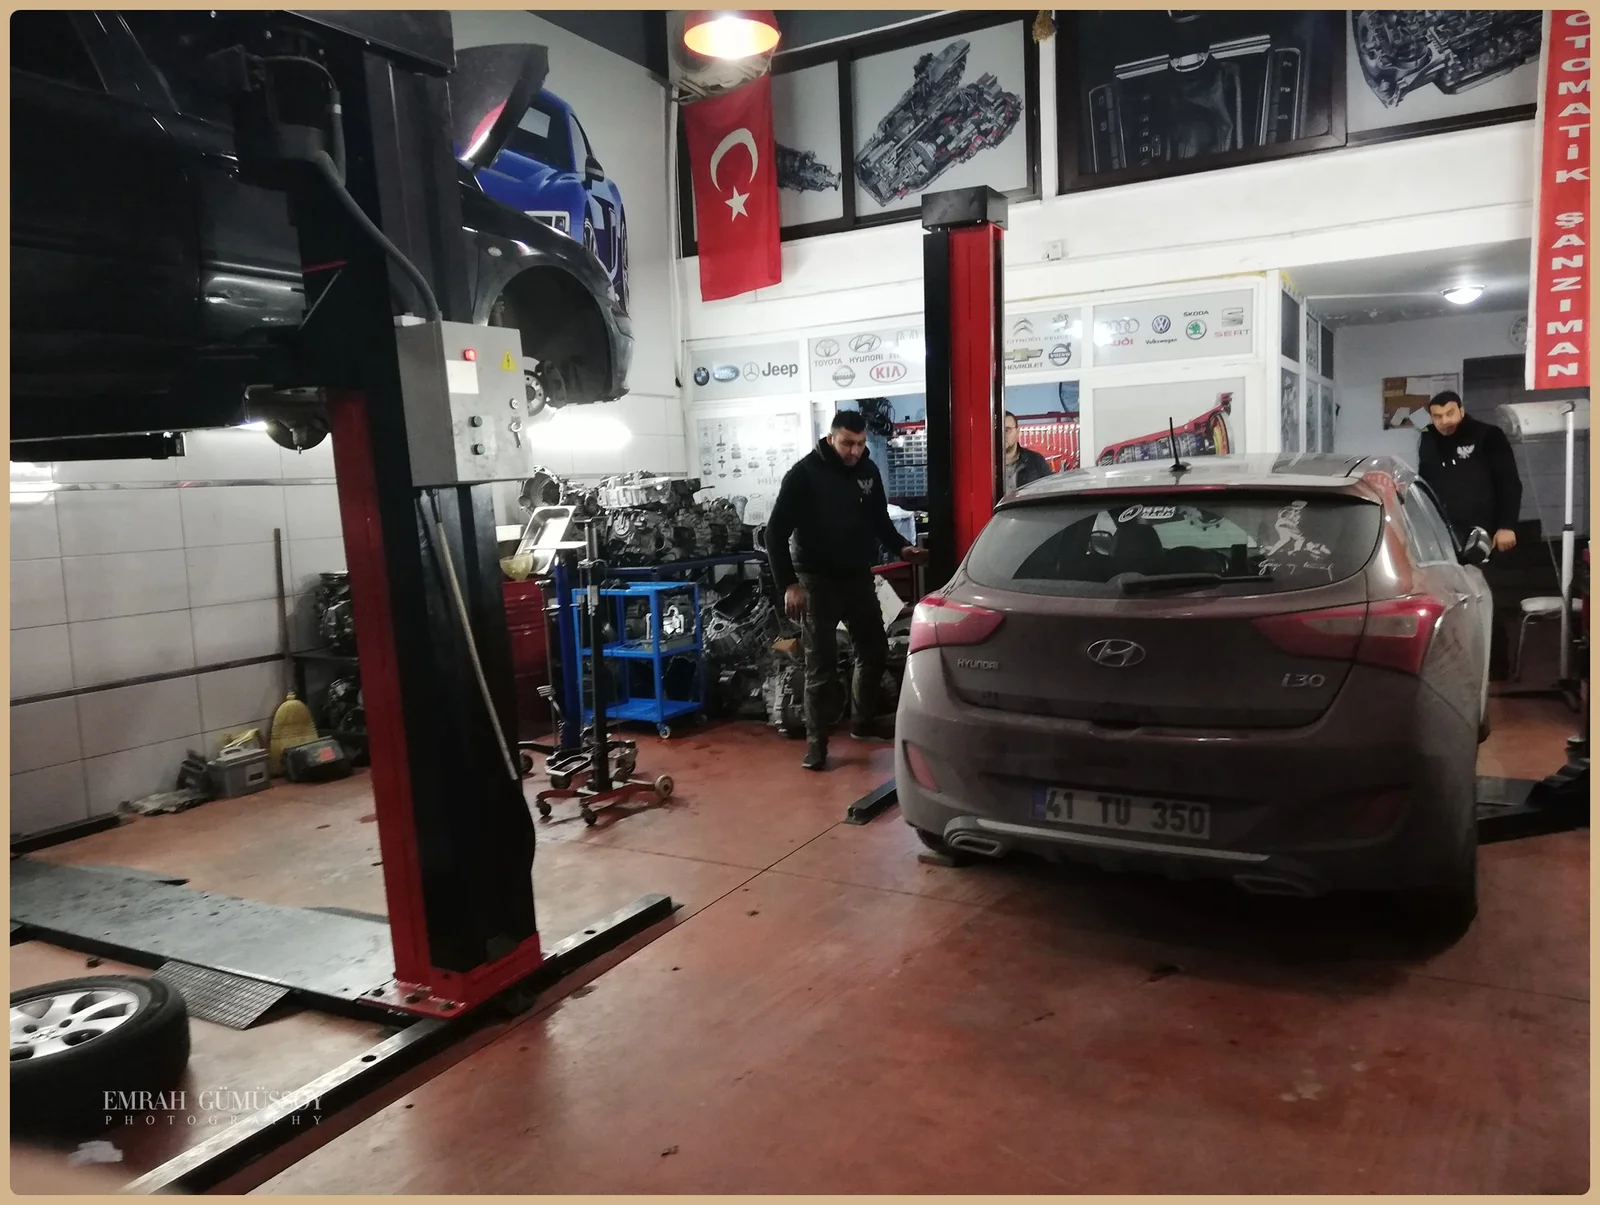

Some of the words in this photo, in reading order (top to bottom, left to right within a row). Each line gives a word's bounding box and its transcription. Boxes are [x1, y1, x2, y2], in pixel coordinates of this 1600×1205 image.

[1547, 212, 1585, 377] ŞANZIMAN
[1213, 329, 1250, 338] SEAT
[1111, 338, 1134, 346] UDI
[814, 358, 843, 367] TOYOTA
[849, 354, 883, 363] HYUNDAI
[762, 362, 799, 377] Jeep
[876, 366, 901, 379] KIA
[1005, 362, 1043, 371] HEVROLET
[956, 658, 998, 671] HYUNDAI
[1281, 672, 1326, 688] i30
[1047, 791, 1074, 819] 41
[1098, 796, 1131, 825] TU
[1152, 803, 1206, 834] 350
